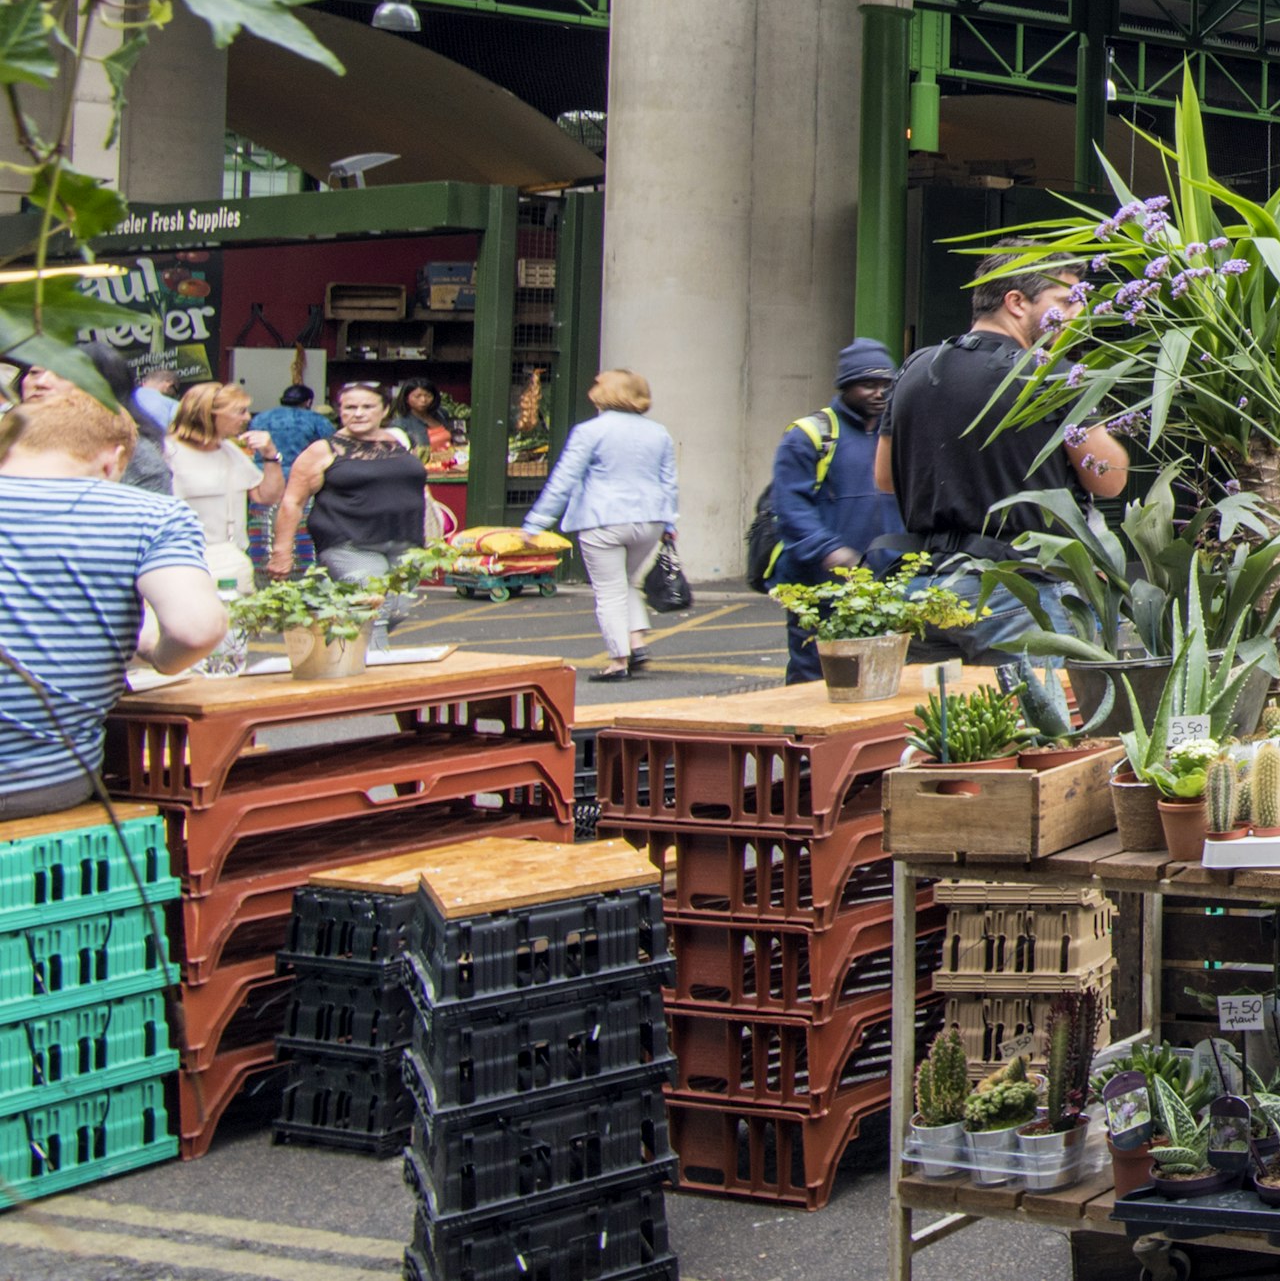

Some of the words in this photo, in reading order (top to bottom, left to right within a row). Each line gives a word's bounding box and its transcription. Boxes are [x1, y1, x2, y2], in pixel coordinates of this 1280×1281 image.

[151, 210, 184, 232] Fresh
[188, 206, 241, 232] Supplies
[1221, 1000, 1262, 1015] 7.50
